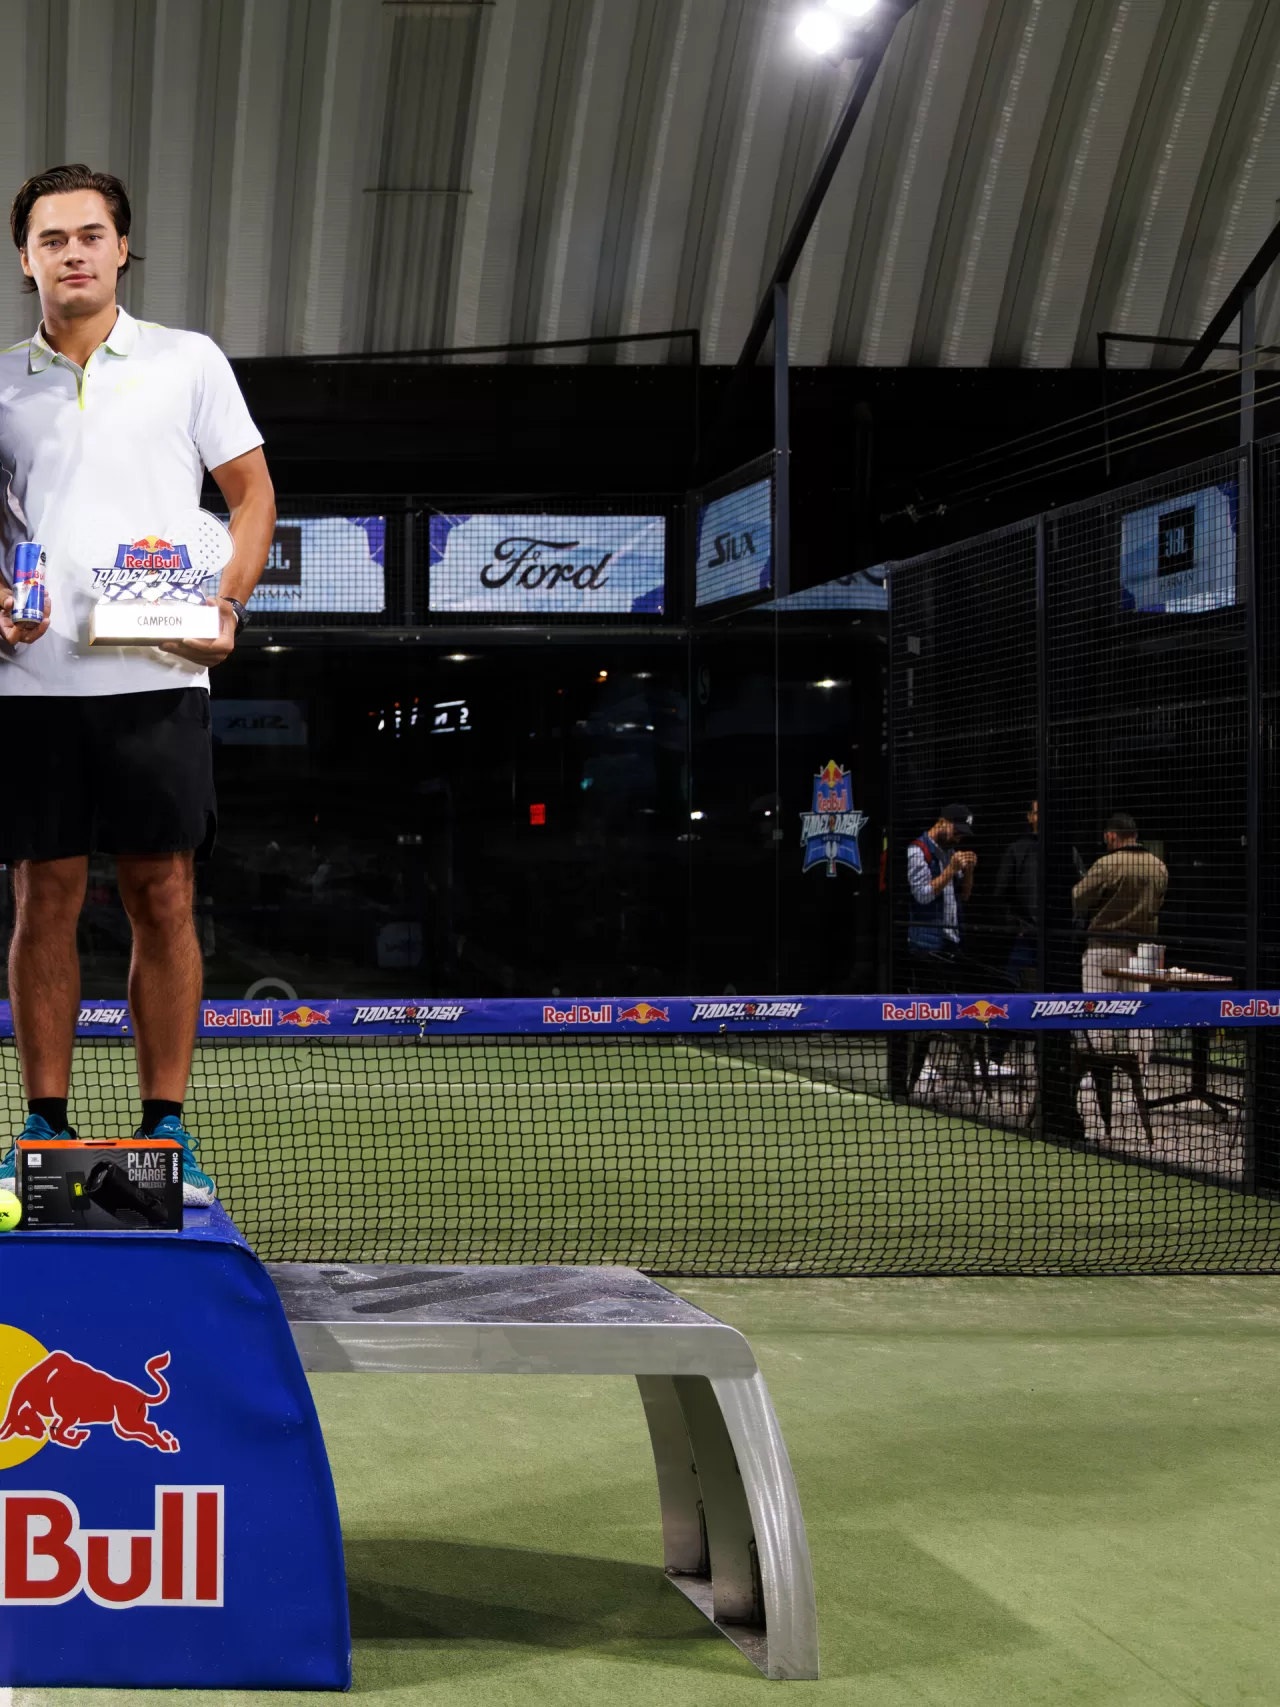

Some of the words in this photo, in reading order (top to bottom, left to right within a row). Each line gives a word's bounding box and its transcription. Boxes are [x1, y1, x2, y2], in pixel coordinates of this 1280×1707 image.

[1164, 526, 1189, 558] JBL
[125, 554, 153, 569] Red
[154, 554, 181, 569] Bull
[479, 537, 613, 590] Ford
[16, 569, 33, 579] Red
[91, 568, 147, 589] PADEL
[157, 568, 205, 585] DASH
[251, 590, 302, 600] ARMAN
[817, 791, 831, 812] Red
[831, 789, 848, 812] Bull
[801, 814, 831, 841] PADEL
[834, 813, 862, 836] DASH
[77, 1008, 127, 1024] DASH
[203, 1009, 239, 1027] Red
[240, 1009, 273, 1027] Bull
[352, 1006, 407, 1025] PADEL
[415, 1006, 464, 1021] DASH
[543, 1005, 578, 1023] Red
[578, 1005, 612, 1023] Bull
[691, 1003, 745, 1021] PADEL
[754, 1002, 803, 1018] DASH
[882, 1001, 918, 1021] Red
[918, 1001, 951, 1021] Bull
[1030, 1000, 1085, 1019] PADEL
[1093, 1000, 1142, 1015] DASH
[1221, 999, 1255, 1018] Red
[1256, 999, 1280, 1018] Bu
[127, 1152, 160, 1168] PLAY
[128, 1168, 167, 1181] CHARGE
[1, 1487, 222, 1606] Bull
